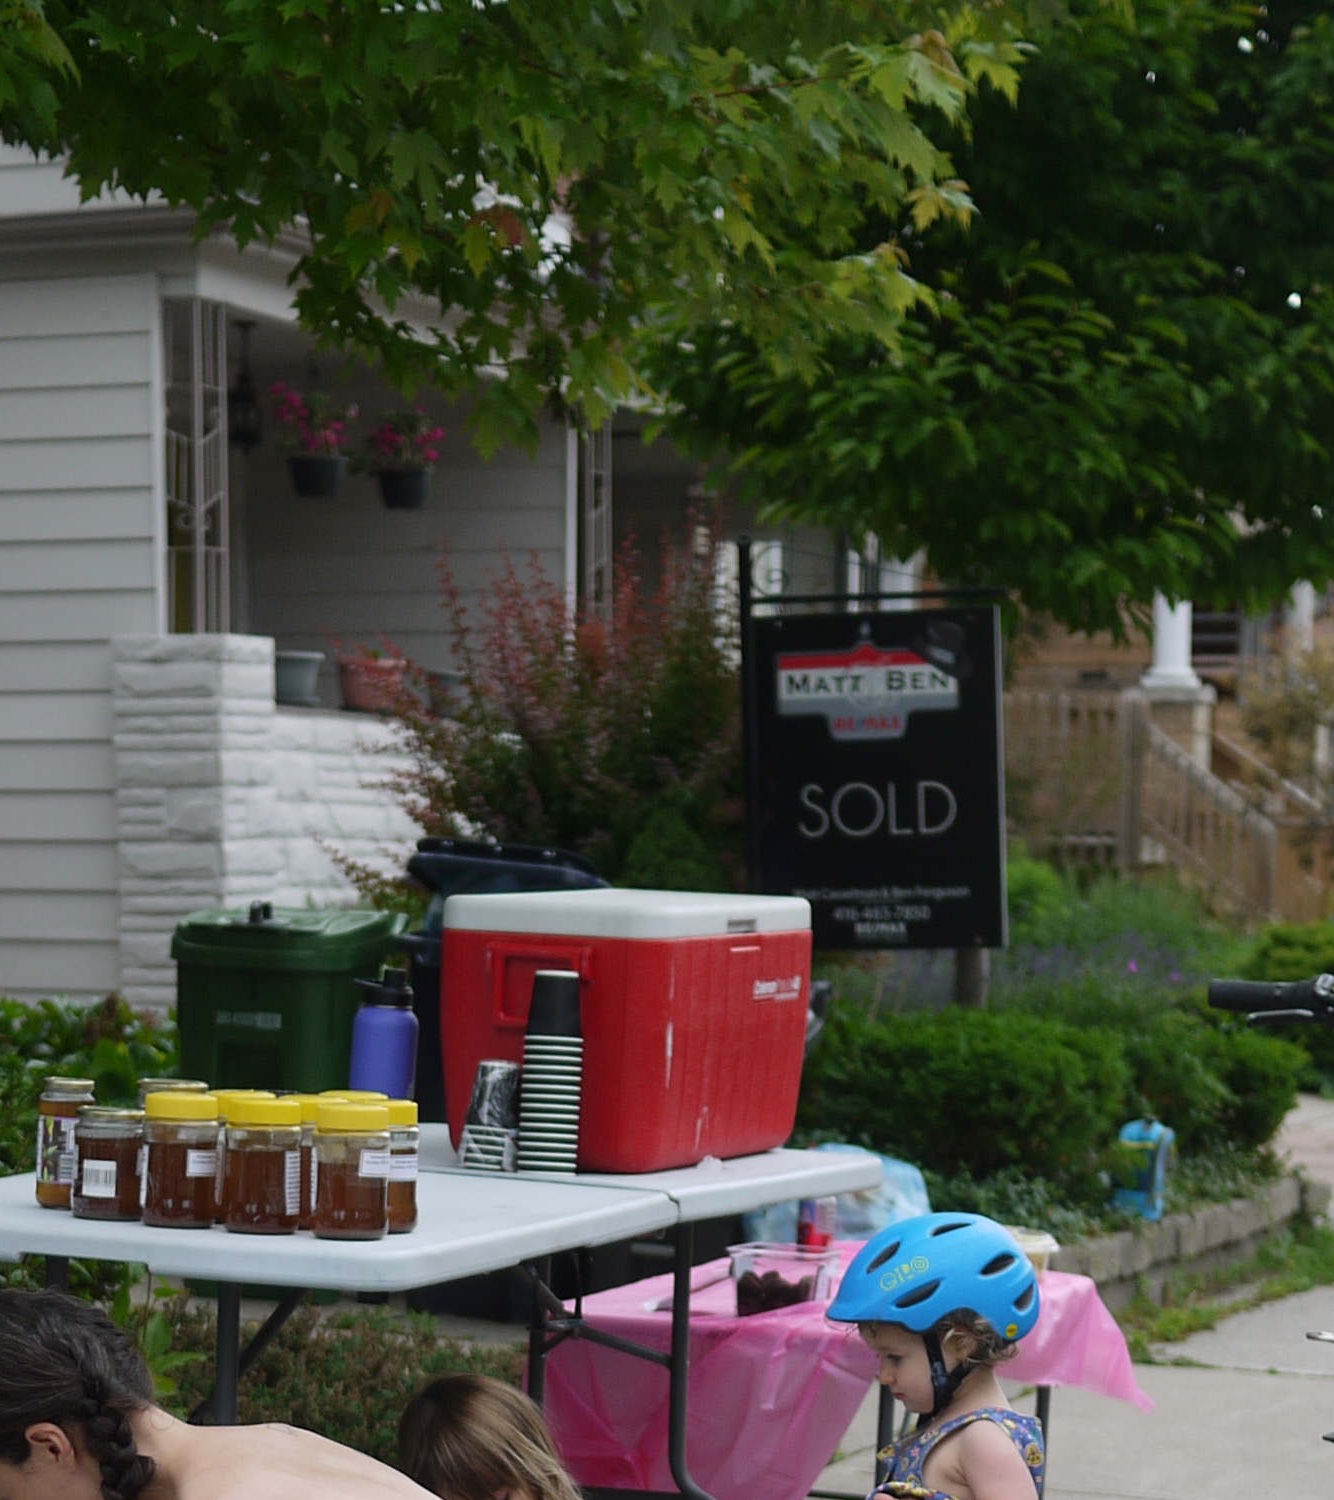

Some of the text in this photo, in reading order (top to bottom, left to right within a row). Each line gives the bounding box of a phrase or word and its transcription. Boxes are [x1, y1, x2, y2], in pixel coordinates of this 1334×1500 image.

[785, 669, 950, 697] MATT BEN
[798, 780, 958, 839] SOLD
